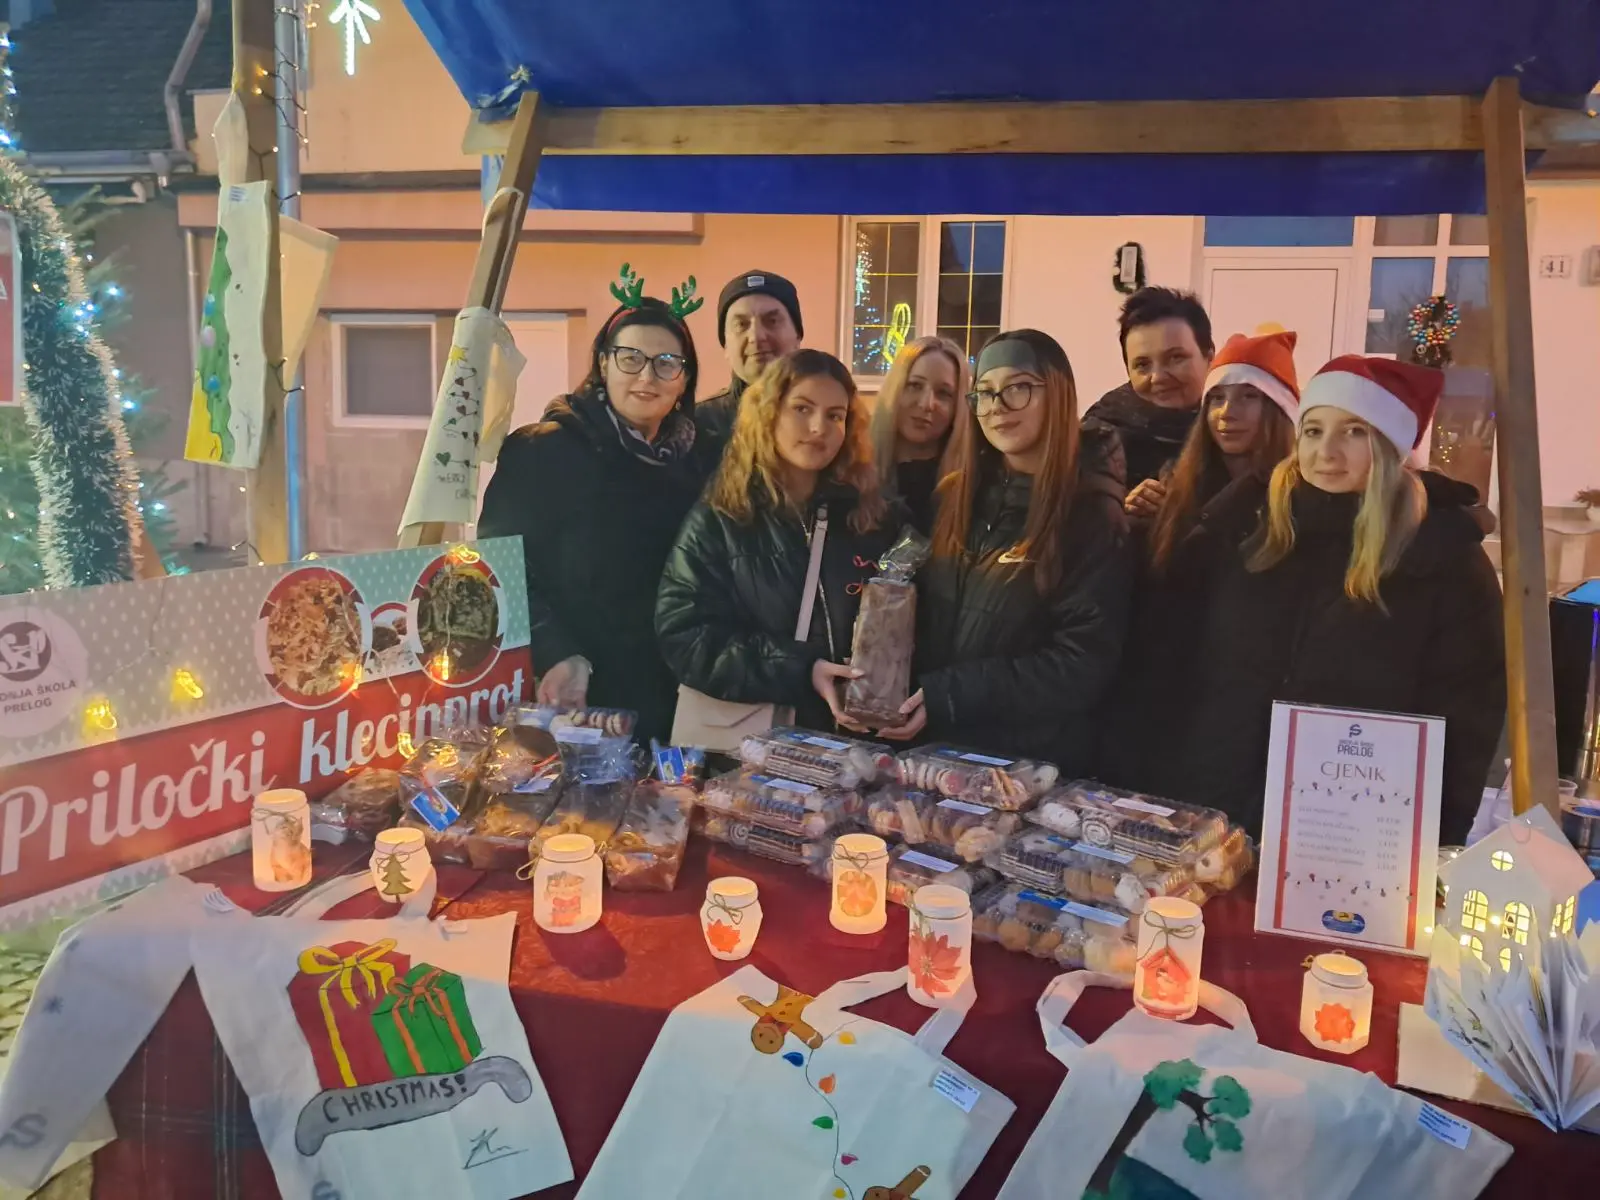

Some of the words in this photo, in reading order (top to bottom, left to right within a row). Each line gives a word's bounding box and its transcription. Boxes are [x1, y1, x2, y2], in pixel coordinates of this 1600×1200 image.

[36, 679, 77, 695] ŠKOLA
[4, 697, 53, 715] PRELOG
[1337, 744, 1375, 758] PRELOG
[1320, 761, 1386, 782] CJENIK
[0, 730, 278, 876] Priločki
[322, 1073, 469, 1123] CHRISTMAS!
